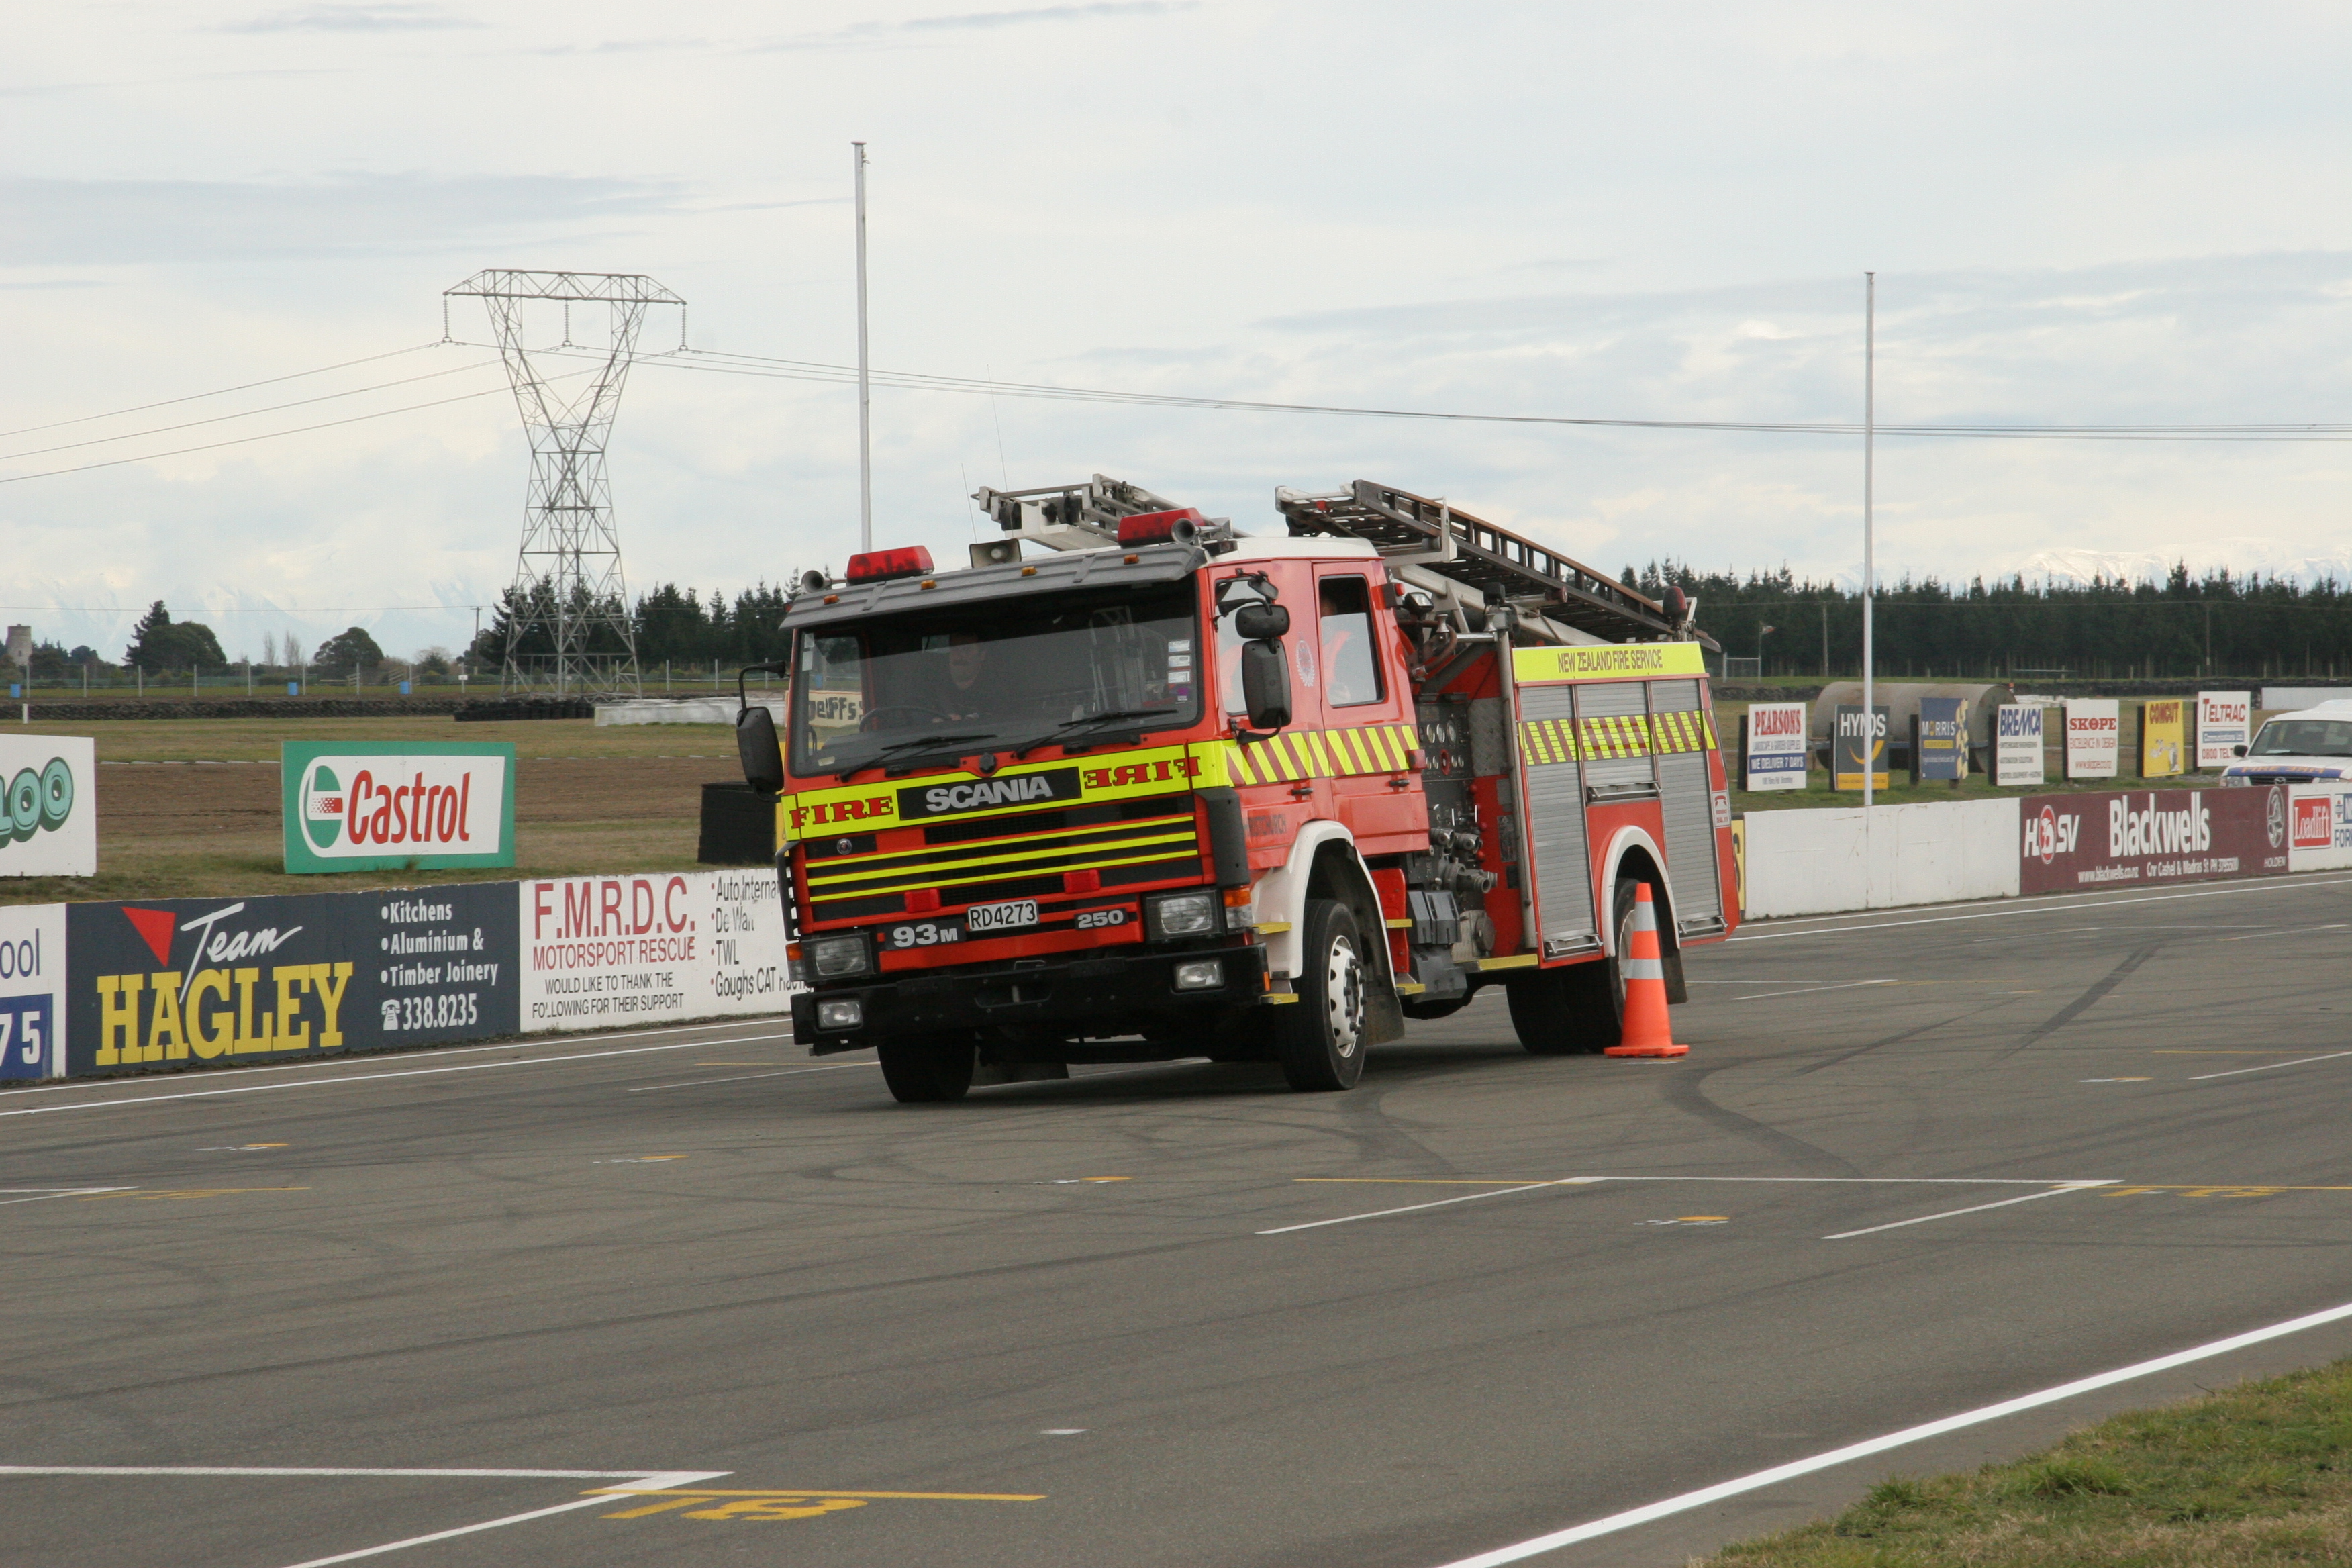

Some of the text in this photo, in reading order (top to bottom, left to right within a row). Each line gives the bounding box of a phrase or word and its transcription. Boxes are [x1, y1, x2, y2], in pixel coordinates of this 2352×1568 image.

[1558, 648, 1663, 673] NEW ZEALAND FIRE SERVICE
[1755, 709, 1802, 736] PEARSONS
[2000, 708, 2041, 736] BREMCA
[2069, 718, 2116, 730] SKOPE
[2203, 698, 2246, 723] TELTRAC
[1922, 720, 1956, 736] MORRIS
[1751, 757, 1761, 770] WE
[1761, 757, 1784, 769] DELIVER
[1789, 756, 1804, 768] DAYS
[347, 769, 471, 845] Castrol
[926, 775, 1054, 812] SCANIA
[789, 796, 894, 829] FIRE
[2109, 791, 2211, 858] Blackwells
[2294, 805, 2330, 840] Loadlift
[2263, 856, 2286, 868] HOLDEN
[716, 875, 739, 902] Auto
[390, 898, 452, 924] Kitchens
[534, 876, 696, 940] F.M.R.D.C.
[970, 902, 1036, 930] RD4273
[1077, 909, 1124, 929] 250
[180, 901, 303, 1004] Team
[390, 927, 484, 954] Aluminium &
[533, 936, 696, 971] MOTORSPORT RESCUE
[716, 939, 740, 967] TWL
[389, 959, 499, 987] Timber Joinery
[545, 971, 673, 995] WOULD LIKE TO THANK THE
[716, 969, 754, 1001] Goughs
[756, 967, 776, 994] CAT
[95, 961, 354, 1066] HAGLEY
[403, 993, 477, 1030] 338.8235
[591, 997, 609, 1014] FOR
[612, 995, 638, 1013] THEIR
[640, 992, 684, 1012] SUPPORT
